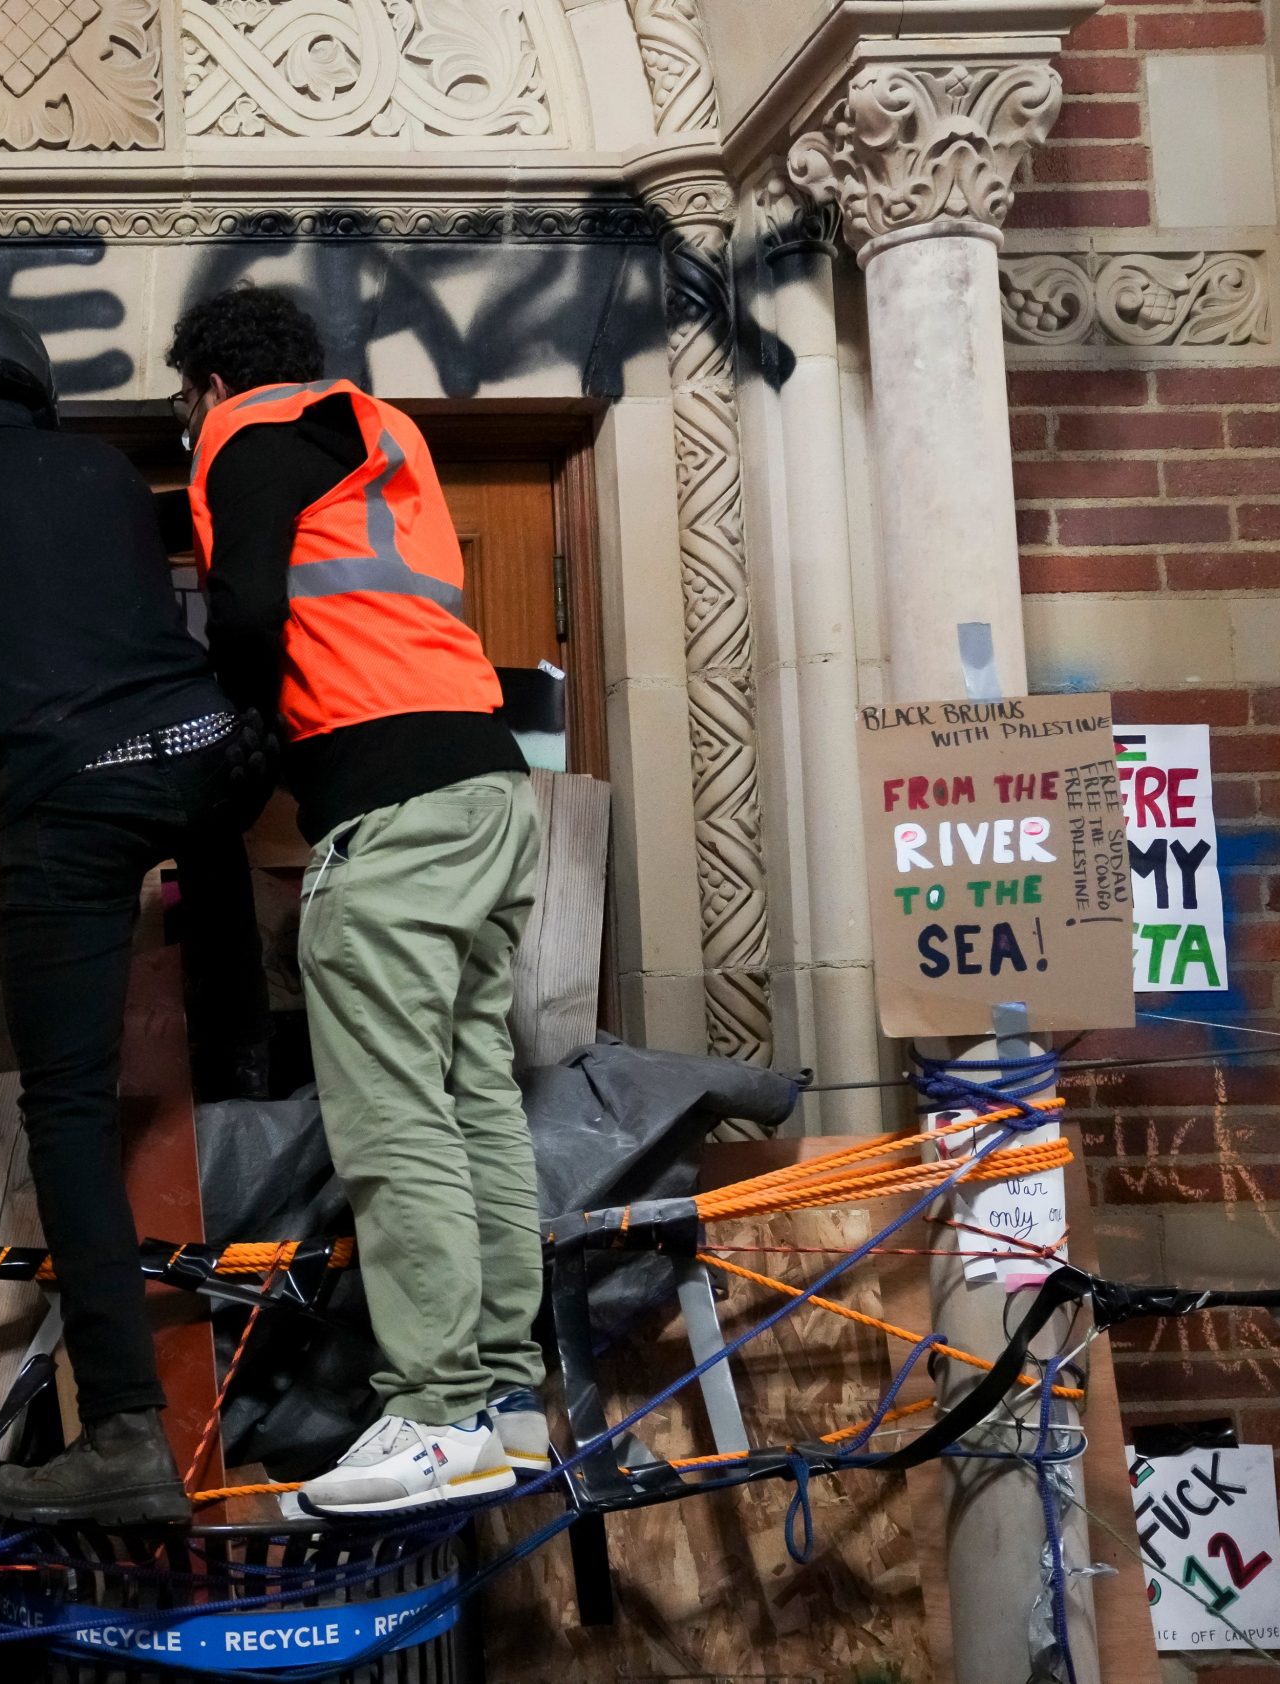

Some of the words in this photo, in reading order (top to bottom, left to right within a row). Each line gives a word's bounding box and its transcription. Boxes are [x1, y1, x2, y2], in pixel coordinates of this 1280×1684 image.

[861, 706, 935, 732] BLACK
[943, 700, 1025, 725] BRUINS
[931, 726, 989, 749] WITH
[1003, 715, 1112, 740] PALESTINE
[883, 774, 976, 813] FROM
[993, 770, 1060, 804] THE
[1064, 766, 1084, 813] FREE
[1079, 762, 1104, 814] FREE
[1098, 759, 1118, 814] FREE
[893, 816, 1058, 873] RIVER
[1088, 817, 1106, 846] THE
[1068, 817, 1090, 911] PALESTINE
[1091, 849, 1111, 911] CONGO
[1107, 828, 1128, 904] SUDAN
[1128, 838, 1211, 910] MY
[894, 883, 945, 916] TO
[967, 874, 1043, 908] THE
[917, 916, 1049, 979] SEA!
[989, 1206, 1039, 1240] only
[1135, 1450, 1248, 1570] FUCK
[1182, 1532, 1273, 1612] 12
[76, 1626, 182, 1652] RECYCLE
[224, 1622, 340, 1652] RECYCLE
[1191, 1628, 1216, 1645] OFF
